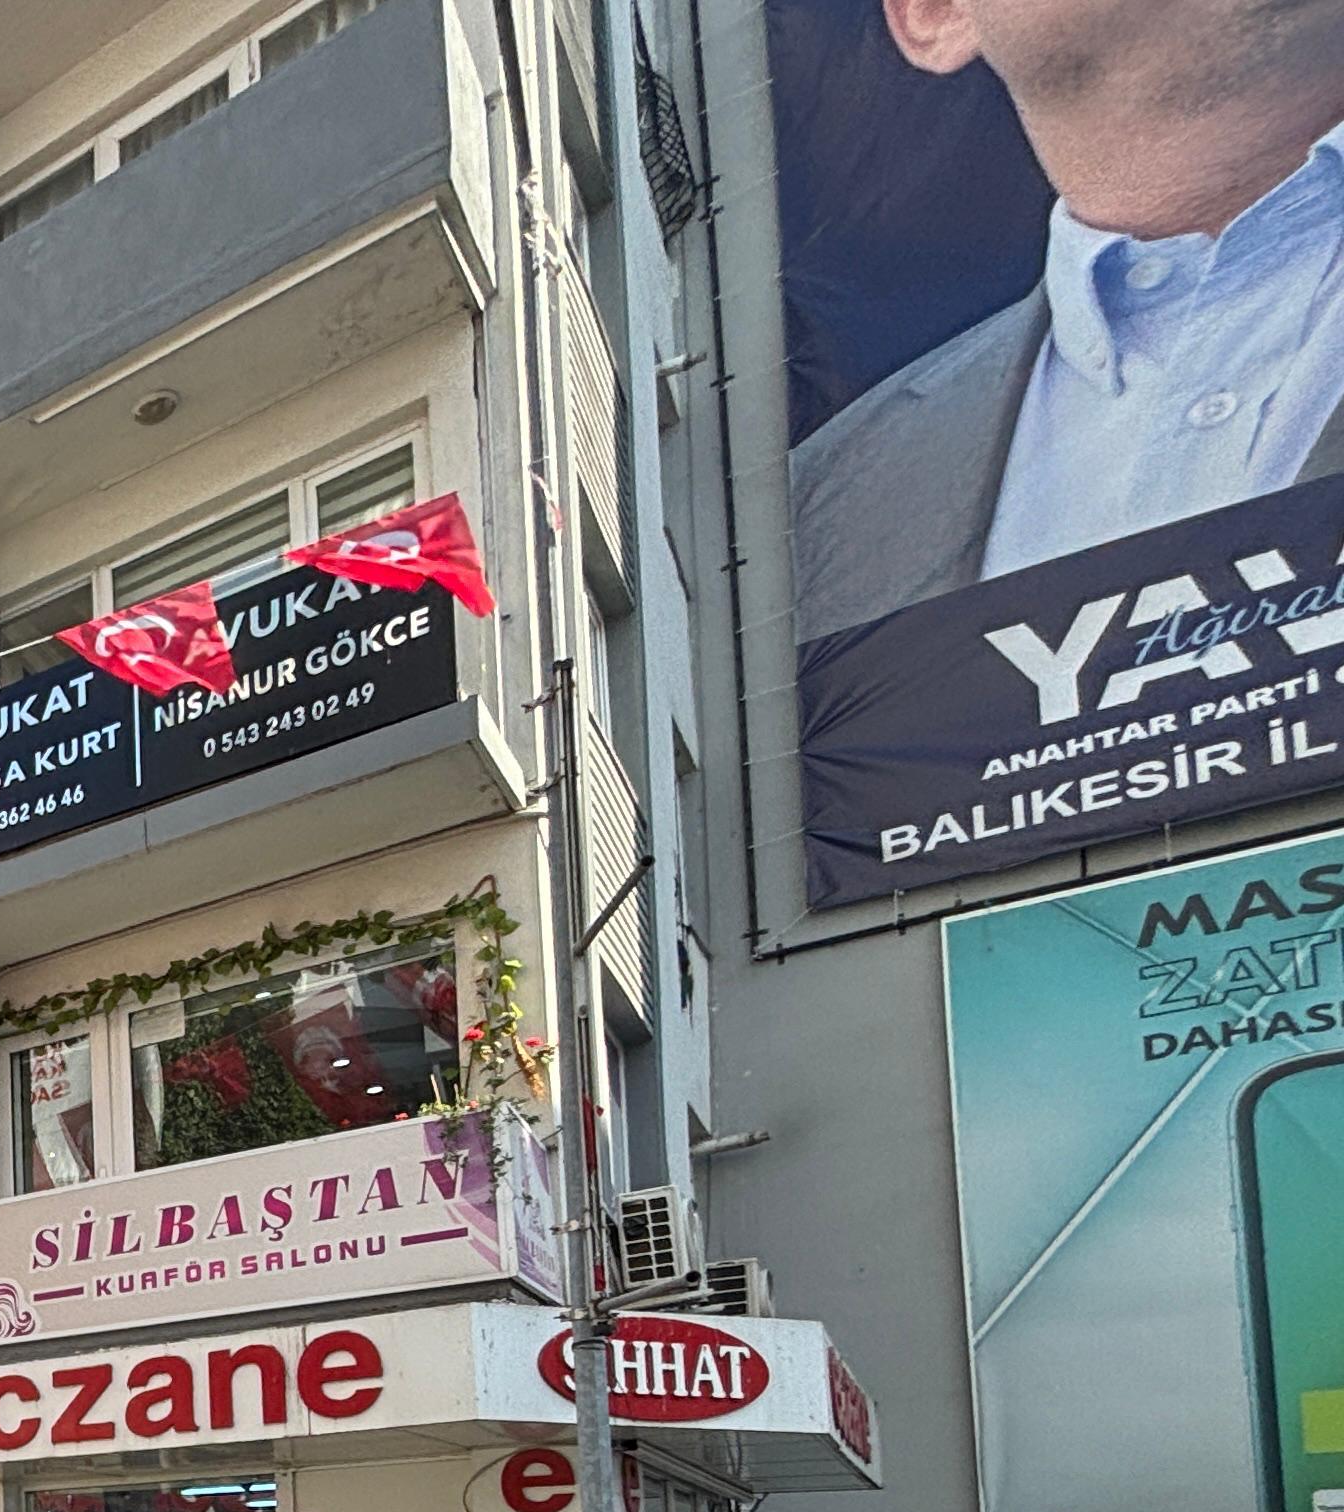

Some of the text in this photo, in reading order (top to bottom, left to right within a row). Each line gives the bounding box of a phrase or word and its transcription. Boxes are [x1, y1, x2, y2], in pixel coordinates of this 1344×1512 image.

[153, 606, 432, 733] NİSANUR GÖKCE
[34, 721, 122, 777] KURT
[203, 681, 376, 760] 0 543 243 02 49
[981, 668, 1320, 781] ANAHTAR PARTİ
[33, 793, 58, 817] 46
[60, 783, 86, 808] 46
[880, 718, 1338, 864] BALIKESİR İL
[32, 1154, 470, 1271] SİLBAŞTAN
[96, 1234, 387, 1298] KUAFÖR SALONU
